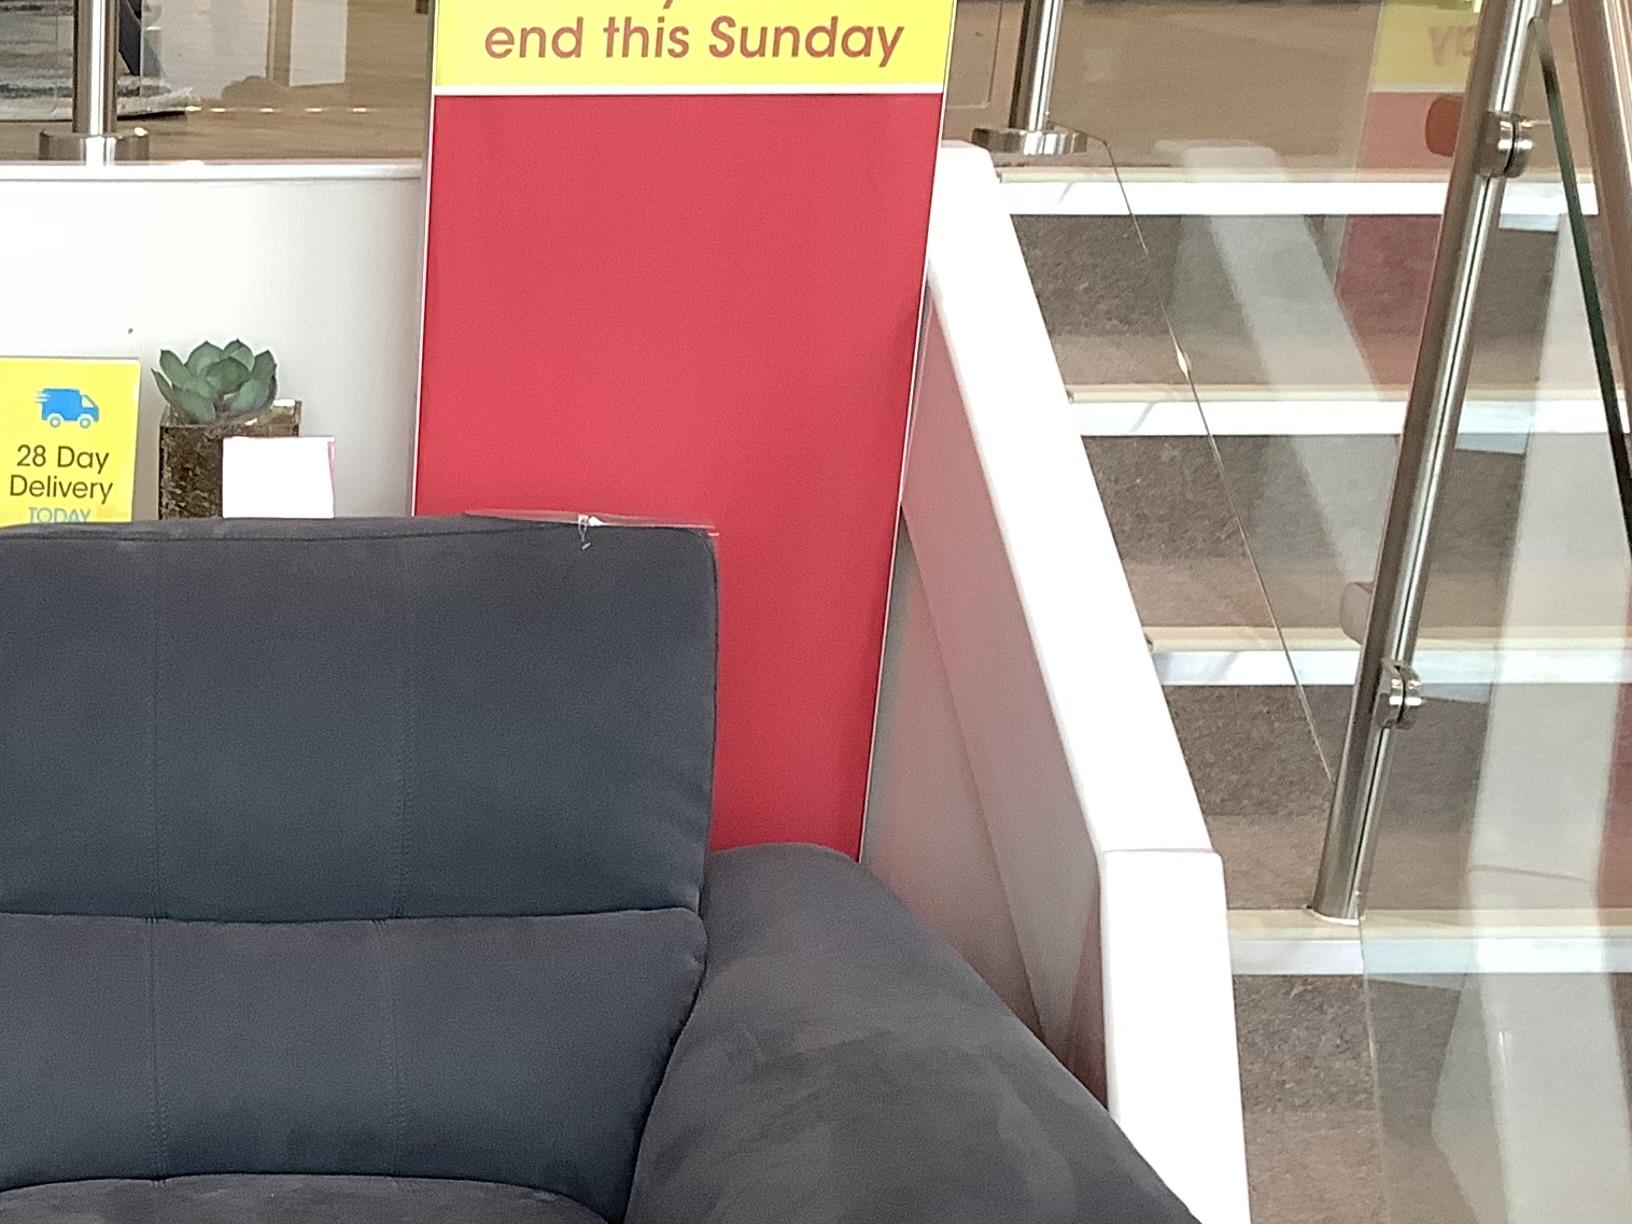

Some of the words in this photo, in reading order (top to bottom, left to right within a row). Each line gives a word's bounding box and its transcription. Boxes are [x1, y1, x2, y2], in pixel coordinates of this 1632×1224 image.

[485, 16, 583, 58] end
[603, 16, 690, 58] this
[709, 15, 905, 67] Sunday
[16, 444, 46, 467] 28
[58, 445, 109, 475] Day
[10, 474, 114, 505] Delivery
[29, 507, 91, 523] TODAY
